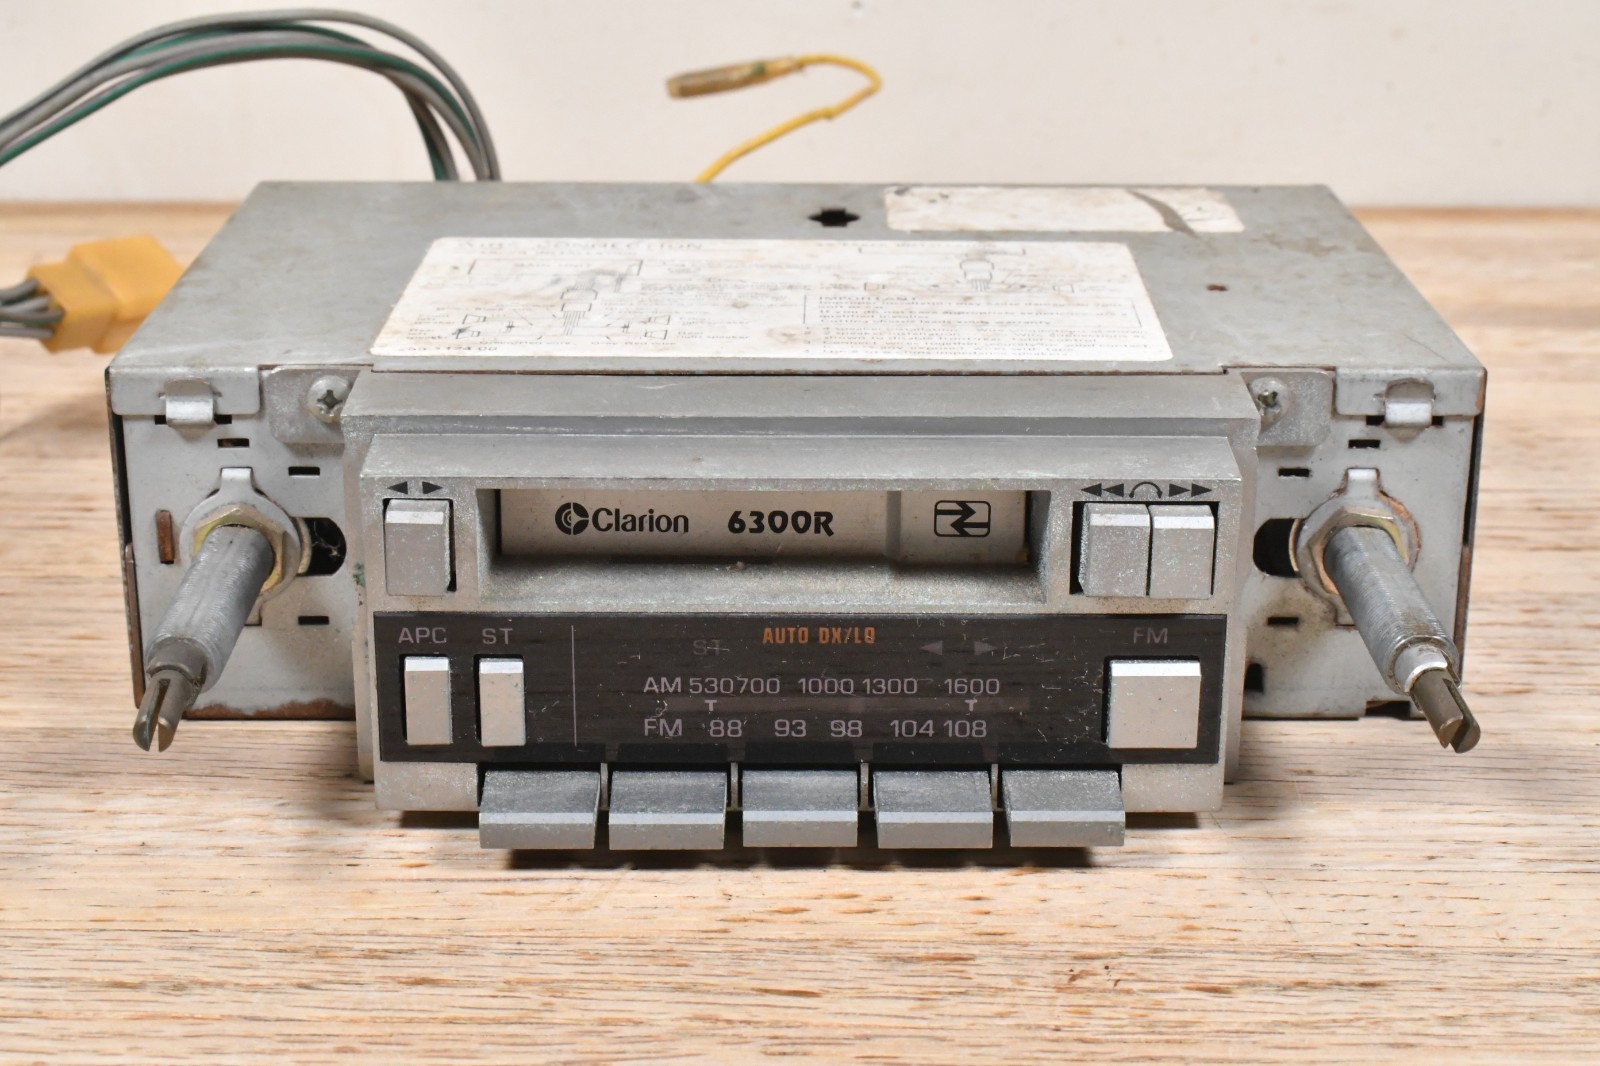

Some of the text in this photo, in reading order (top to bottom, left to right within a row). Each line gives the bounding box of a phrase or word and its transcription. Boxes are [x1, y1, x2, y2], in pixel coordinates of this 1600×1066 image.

[592, 507, 834, 537] Clarion 6300R
[398, 627, 447, 644] APC
[481, 627, 513, 645] ST
[762, 627, 809, 644] AUTO
[1133, 627, 1169, 644] FM
[643, 676, 682, 693] AM
[797, 677, 855, 694] 1000
[862, 678, 919, 694] 1300
[943, 678, 1000, 694] 1600
[643, 718, 988, 737] FM 88 93 98 104 108
